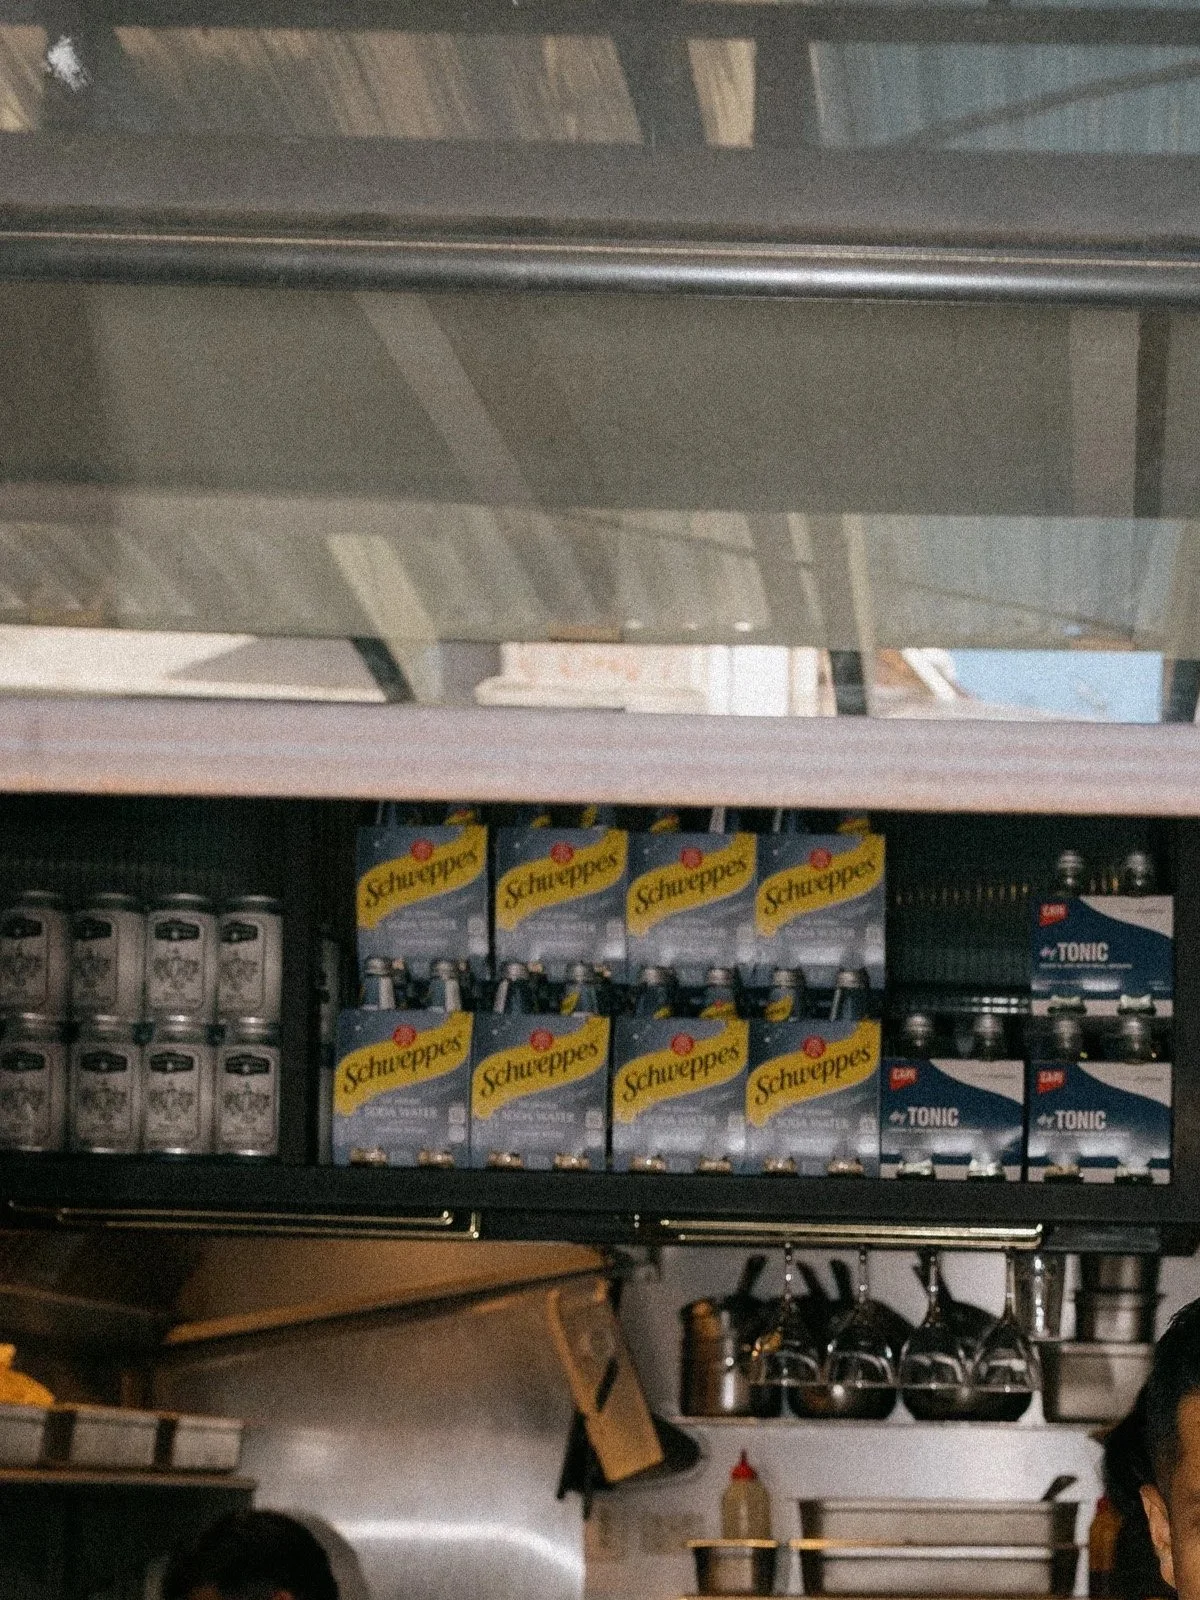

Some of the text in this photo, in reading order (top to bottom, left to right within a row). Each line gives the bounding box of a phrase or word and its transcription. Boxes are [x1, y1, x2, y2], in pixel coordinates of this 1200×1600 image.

[364, 849, 478, 908] Schweppes
[504, 851, 618, 910] Schweppes
[634, 856, 748, 915] Schweppes
[763, 858, 877, 916] Schweppes
[1057, 942, 1109, 962] TONIC
[343, 1036, 462, 1094] Schweppes
[480, 1041, 599, 1099] Schweppes
[622, 1044, 740, 1103] Schweppes
[754, 1046, 871, 1105] Schweppes
[907, 1106, 960, 1127] TONIC
[1054, 1110, 1106, 1131] TONIC
